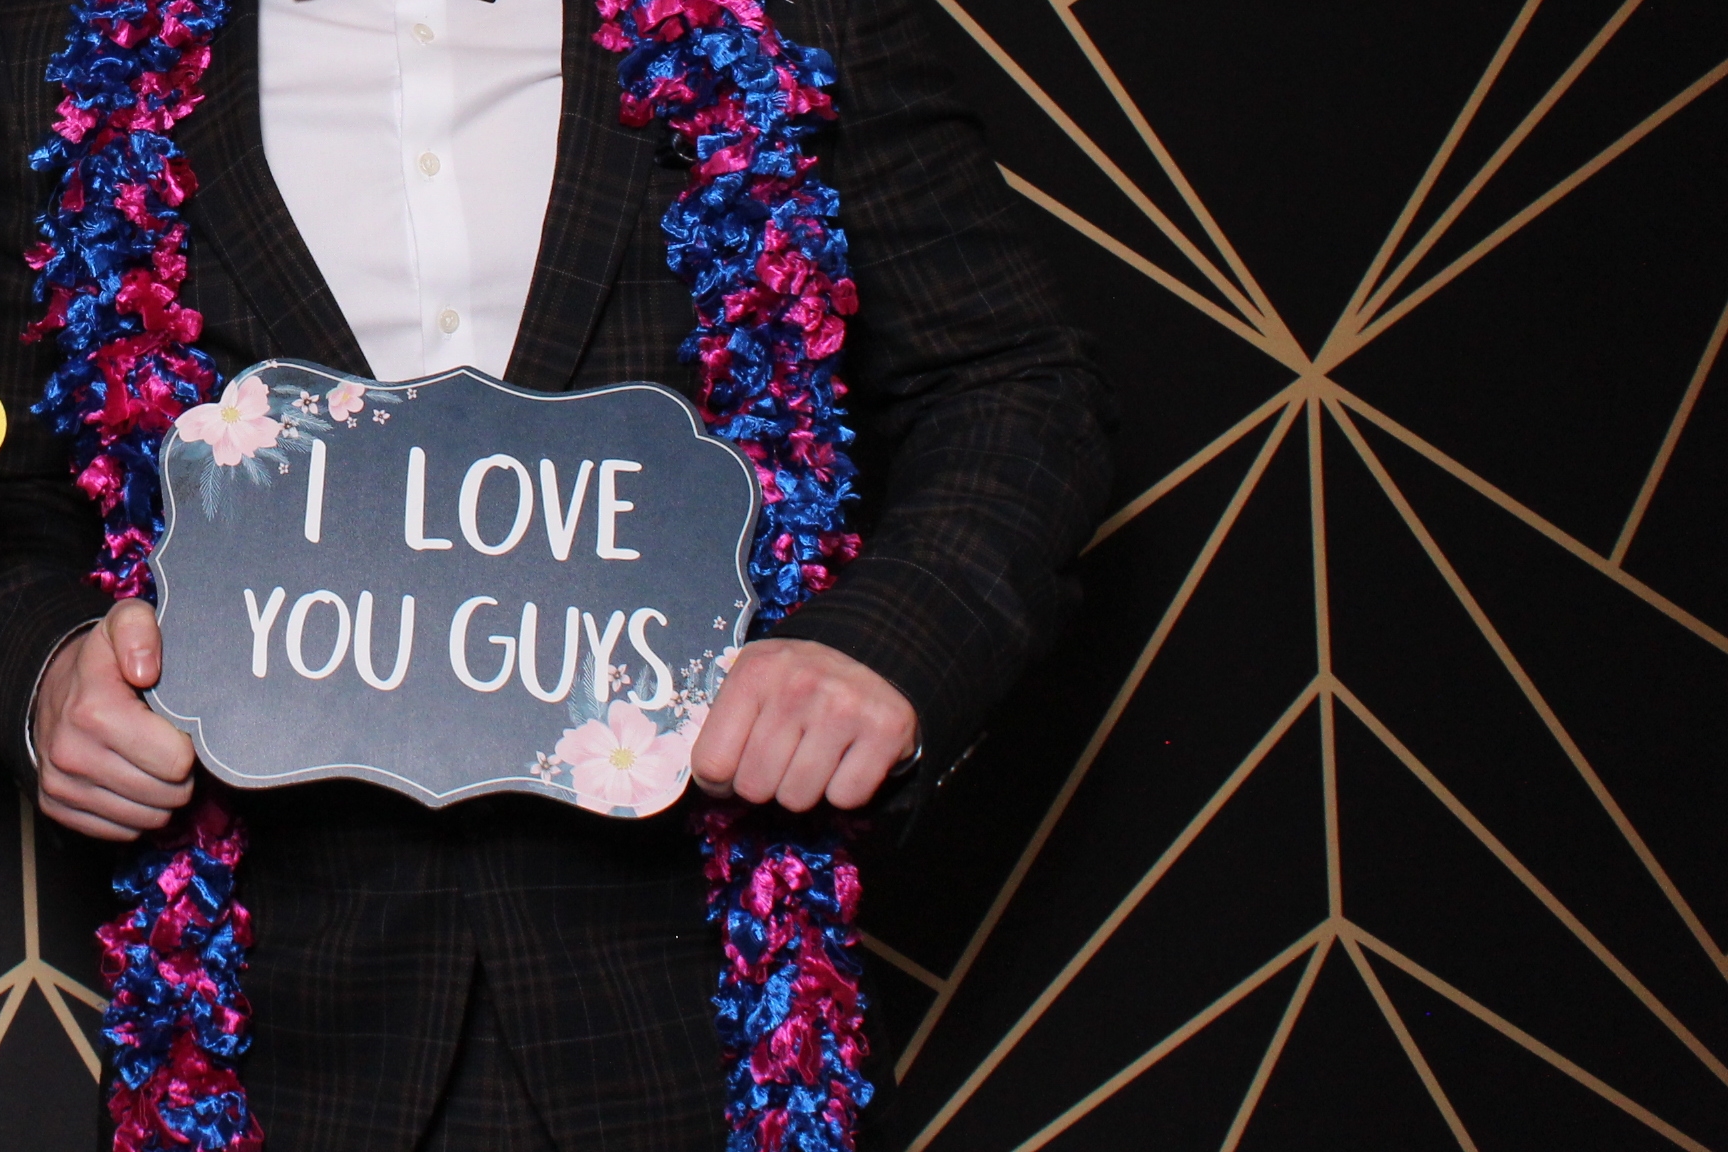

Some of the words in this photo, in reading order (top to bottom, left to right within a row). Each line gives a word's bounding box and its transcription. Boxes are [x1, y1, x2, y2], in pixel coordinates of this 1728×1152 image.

[304, 439, 326, 543] I
[405, 447, 642, 560] LOVE
[244, 587, 414, 690] YOU
[449, 596, 673, 709] GUYS
